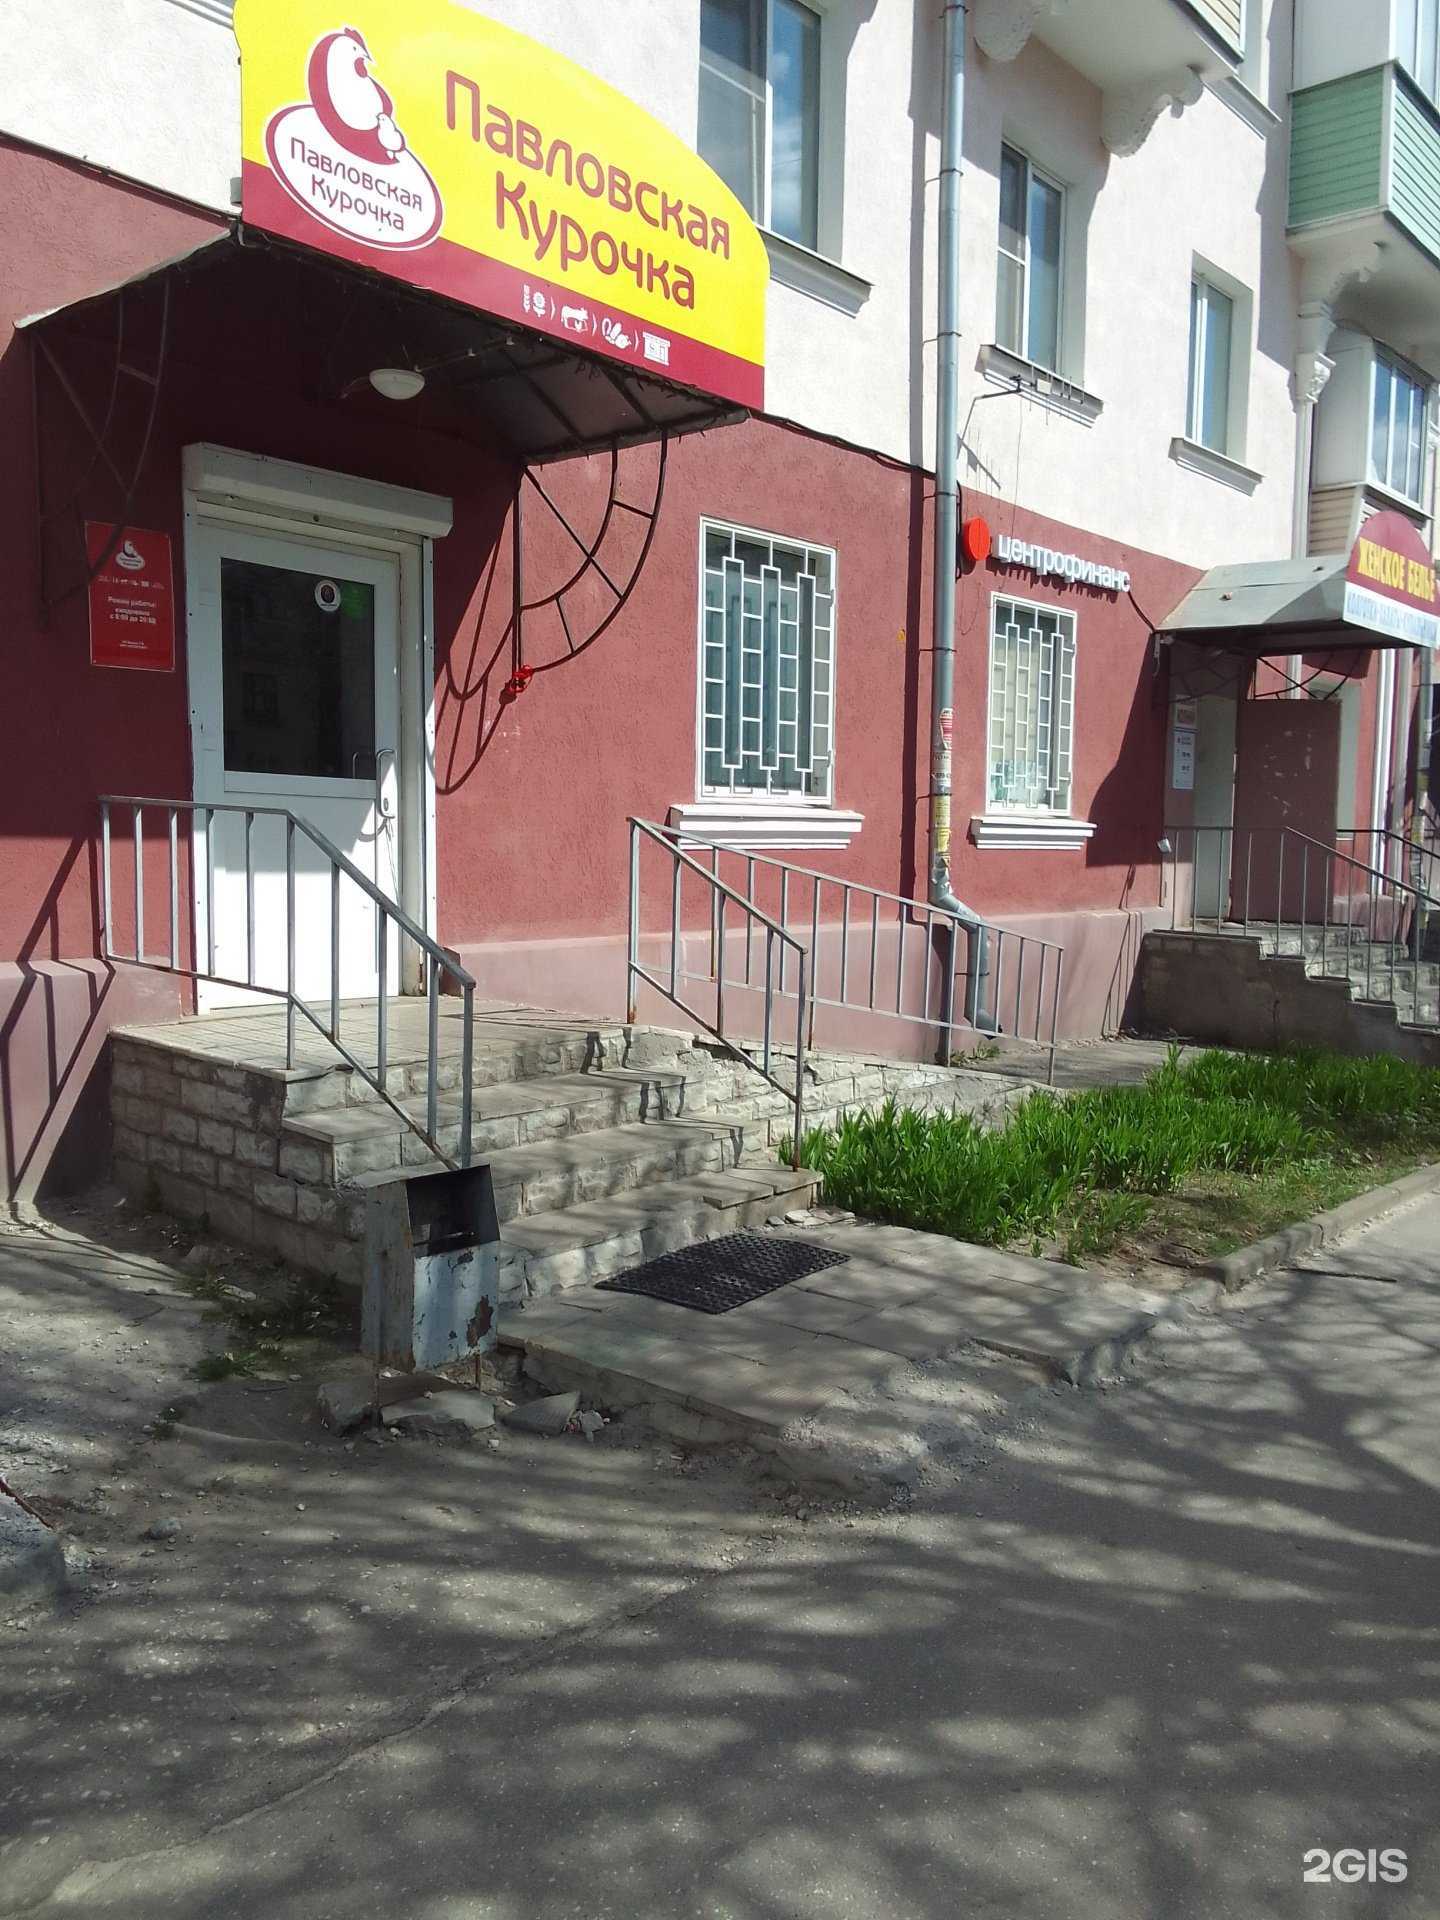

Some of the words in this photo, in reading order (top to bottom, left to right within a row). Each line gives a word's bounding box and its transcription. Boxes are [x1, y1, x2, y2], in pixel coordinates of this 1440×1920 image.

[291, 136, 423, 212] Павловская
[311, 174, 405, 231] Курочка
[445, 69, 731, 260] Павловская
[495, 170, 696, 310] Курочка
[998, 535, 1131, 592] центрофинанс
